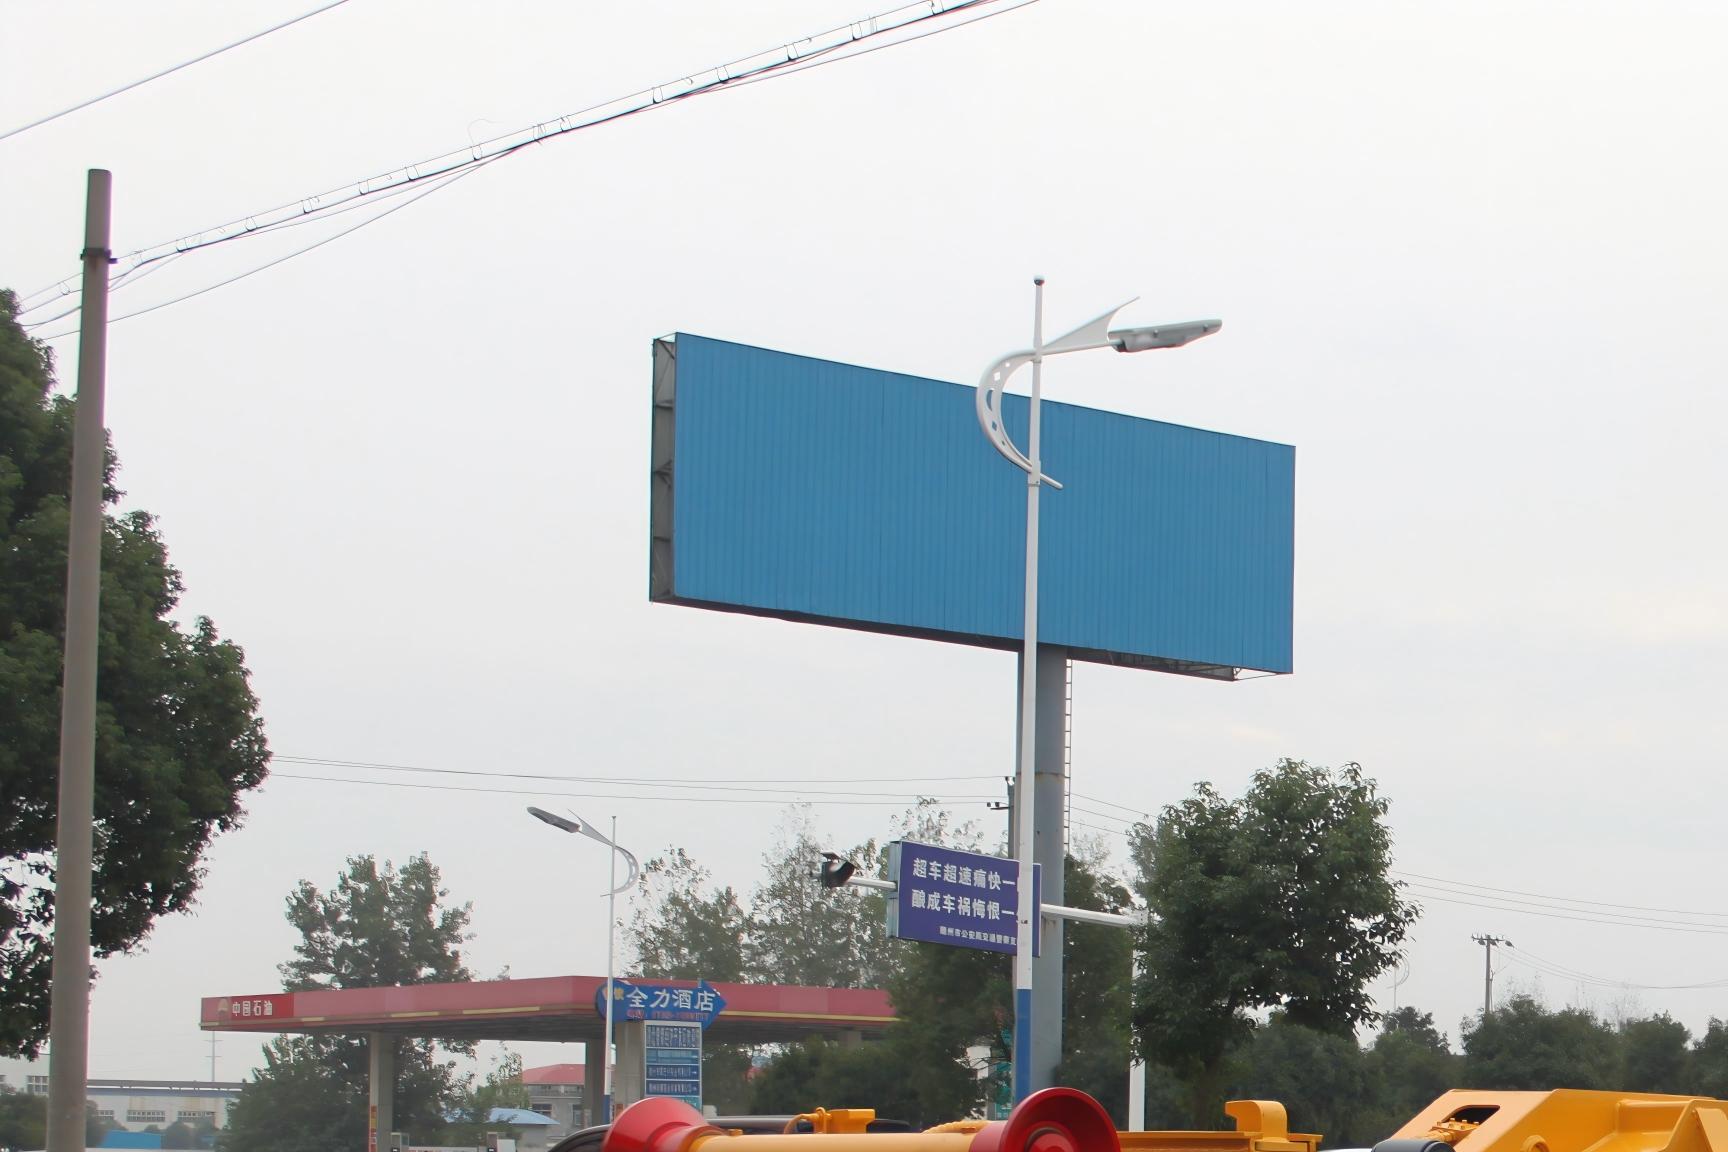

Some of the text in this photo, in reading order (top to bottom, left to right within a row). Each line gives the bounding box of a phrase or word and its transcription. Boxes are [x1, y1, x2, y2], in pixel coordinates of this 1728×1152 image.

[913, 858, 1018, 890] 超车超速痛快一
[912, 888, 1018, 920] 酿成车祸悔恨一
[233, 1000, 272, 1016] 中国石油
[626, 986, 716, 1012] 全力酒店
